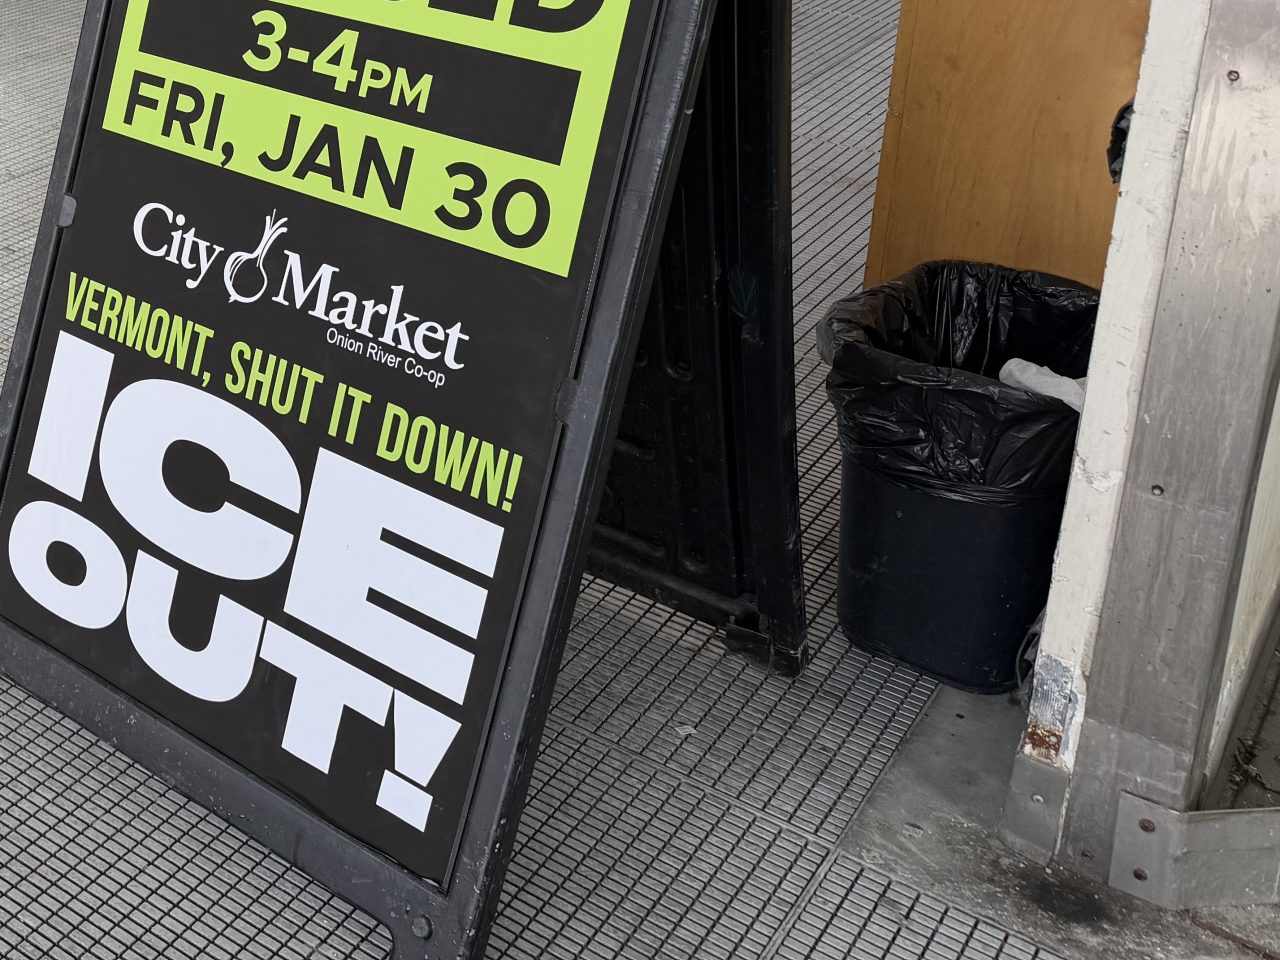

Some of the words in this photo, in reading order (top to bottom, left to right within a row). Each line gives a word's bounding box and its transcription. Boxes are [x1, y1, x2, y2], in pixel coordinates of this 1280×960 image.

[242, 10, 434, 114] 3-4PM
[123, 69, 235, 168] FRI,
[257, 114, 414, 211] JAN
[433, 162, 551, 249] 30
[133, 202, 224, 289] City
[272, 249, 469, 370] Market
[326, 327, 364, 355] Onion
[369, 342, 402, 369] River
[404, 354, 446, 389] Co-op
[65, 271, 215, 388] VERMONT,
[224, 341, 324, 424] SHUT
[328, 382, 372, 444] IT
[376, 401, 524, 513] DOWN!
[27, 330, 505, 706] ICE
[8, 500, 462, 833] OUT!
